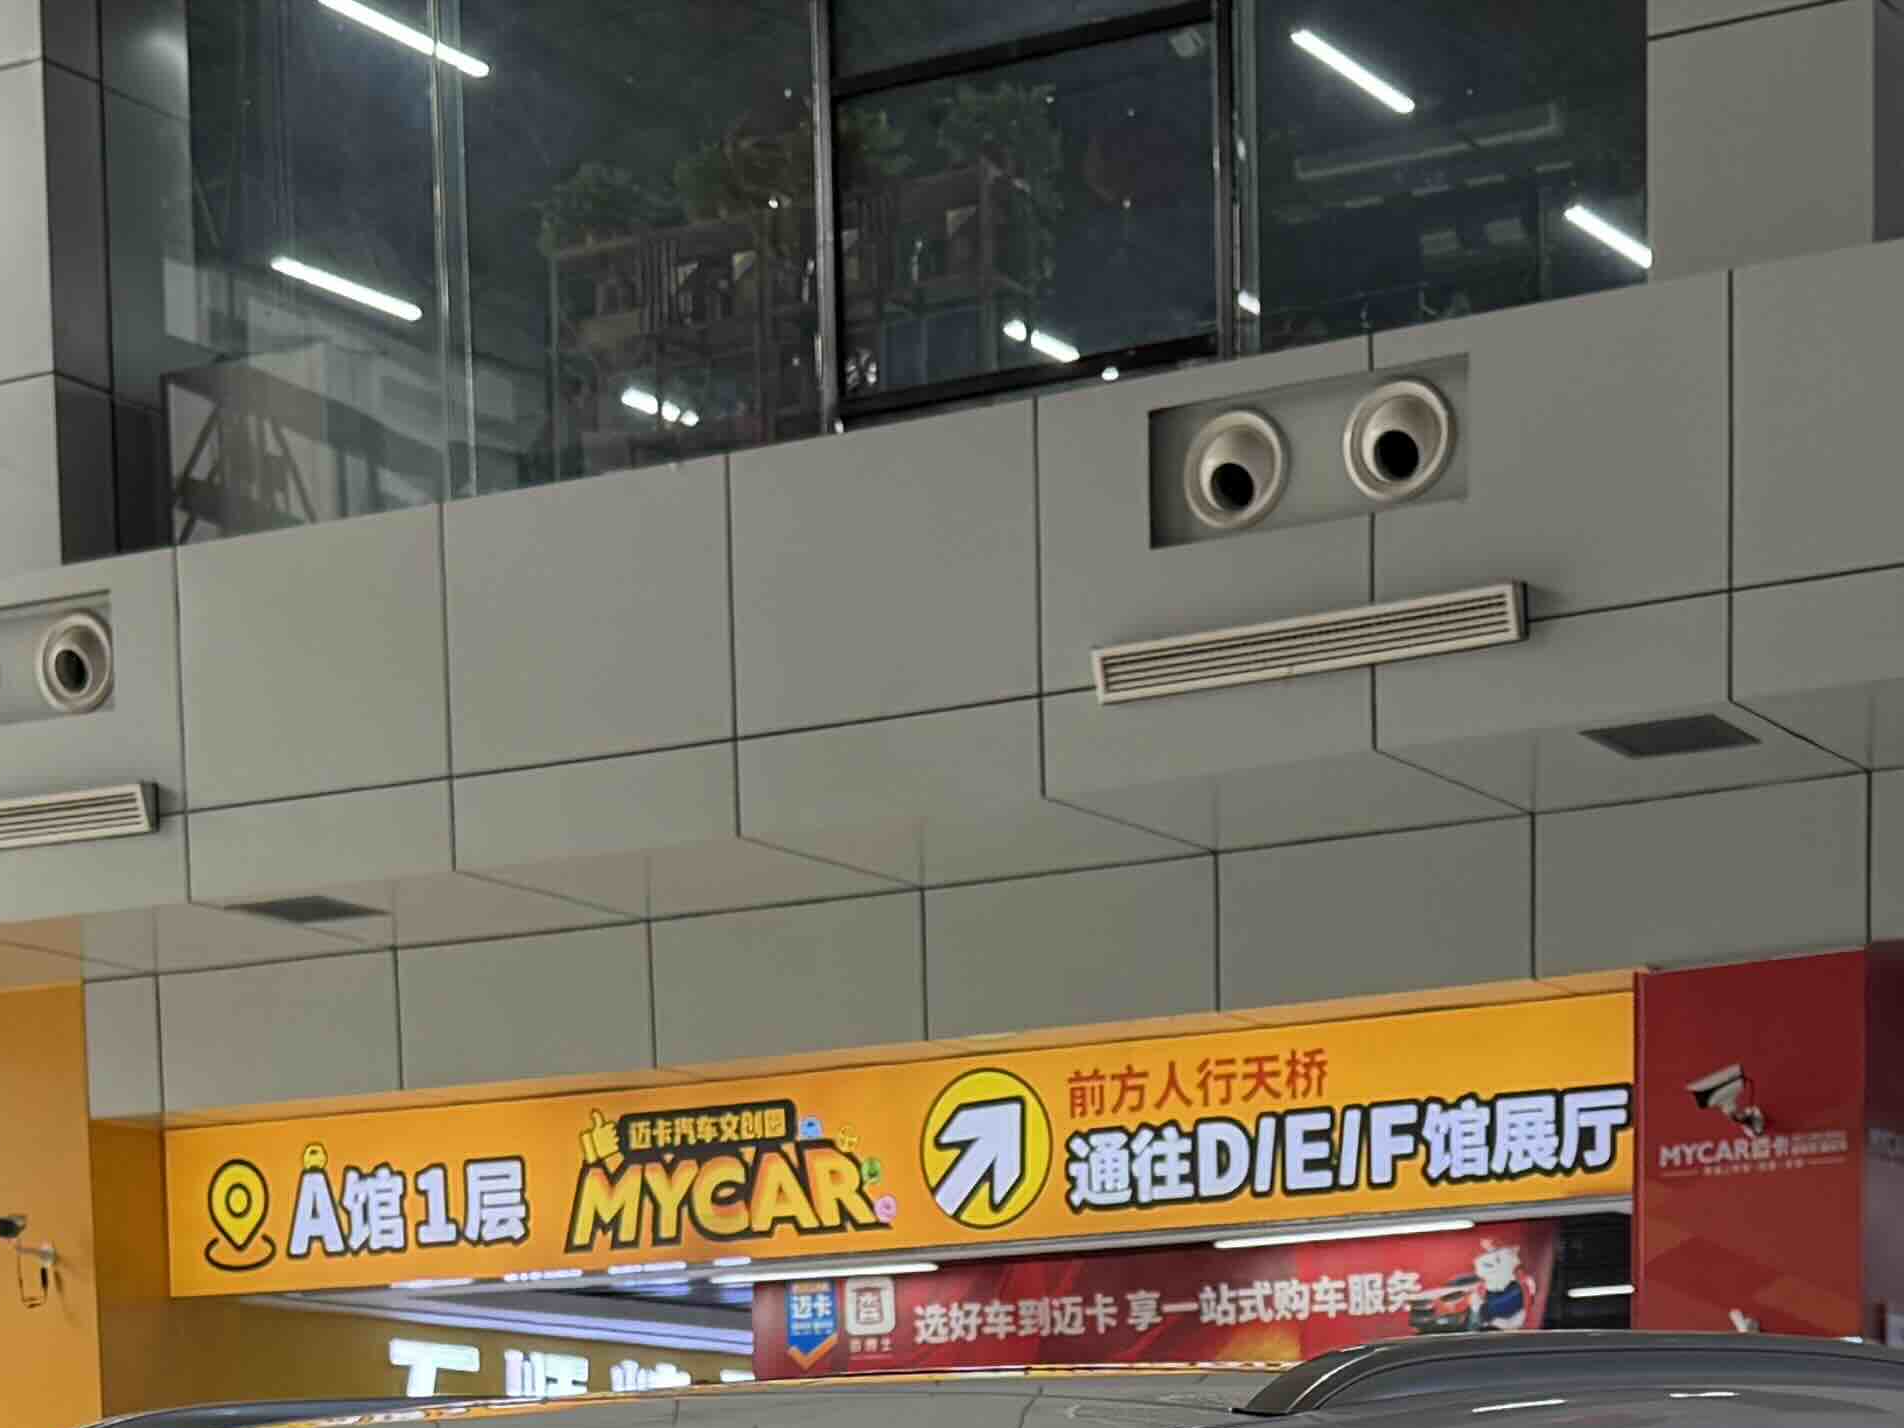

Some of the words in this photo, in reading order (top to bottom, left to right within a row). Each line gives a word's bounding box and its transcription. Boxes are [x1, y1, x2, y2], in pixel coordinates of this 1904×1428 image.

[1067, 1048, 1329, 1119] 前方人行天桥
[628, 1108, 787, 1150] 迈卡汽车文创园
[1068, 1086, 1629, 1207] 通往D/E/F馆展厅
[289, 1158, 529, 1257] A馆1层
[568, 1146, 882, 1250] MYCAR
[913, 1292, 1118, 1344] 选好车到迈卡
[1125, 1269, 1424, 1334] 享一站式购车服务
